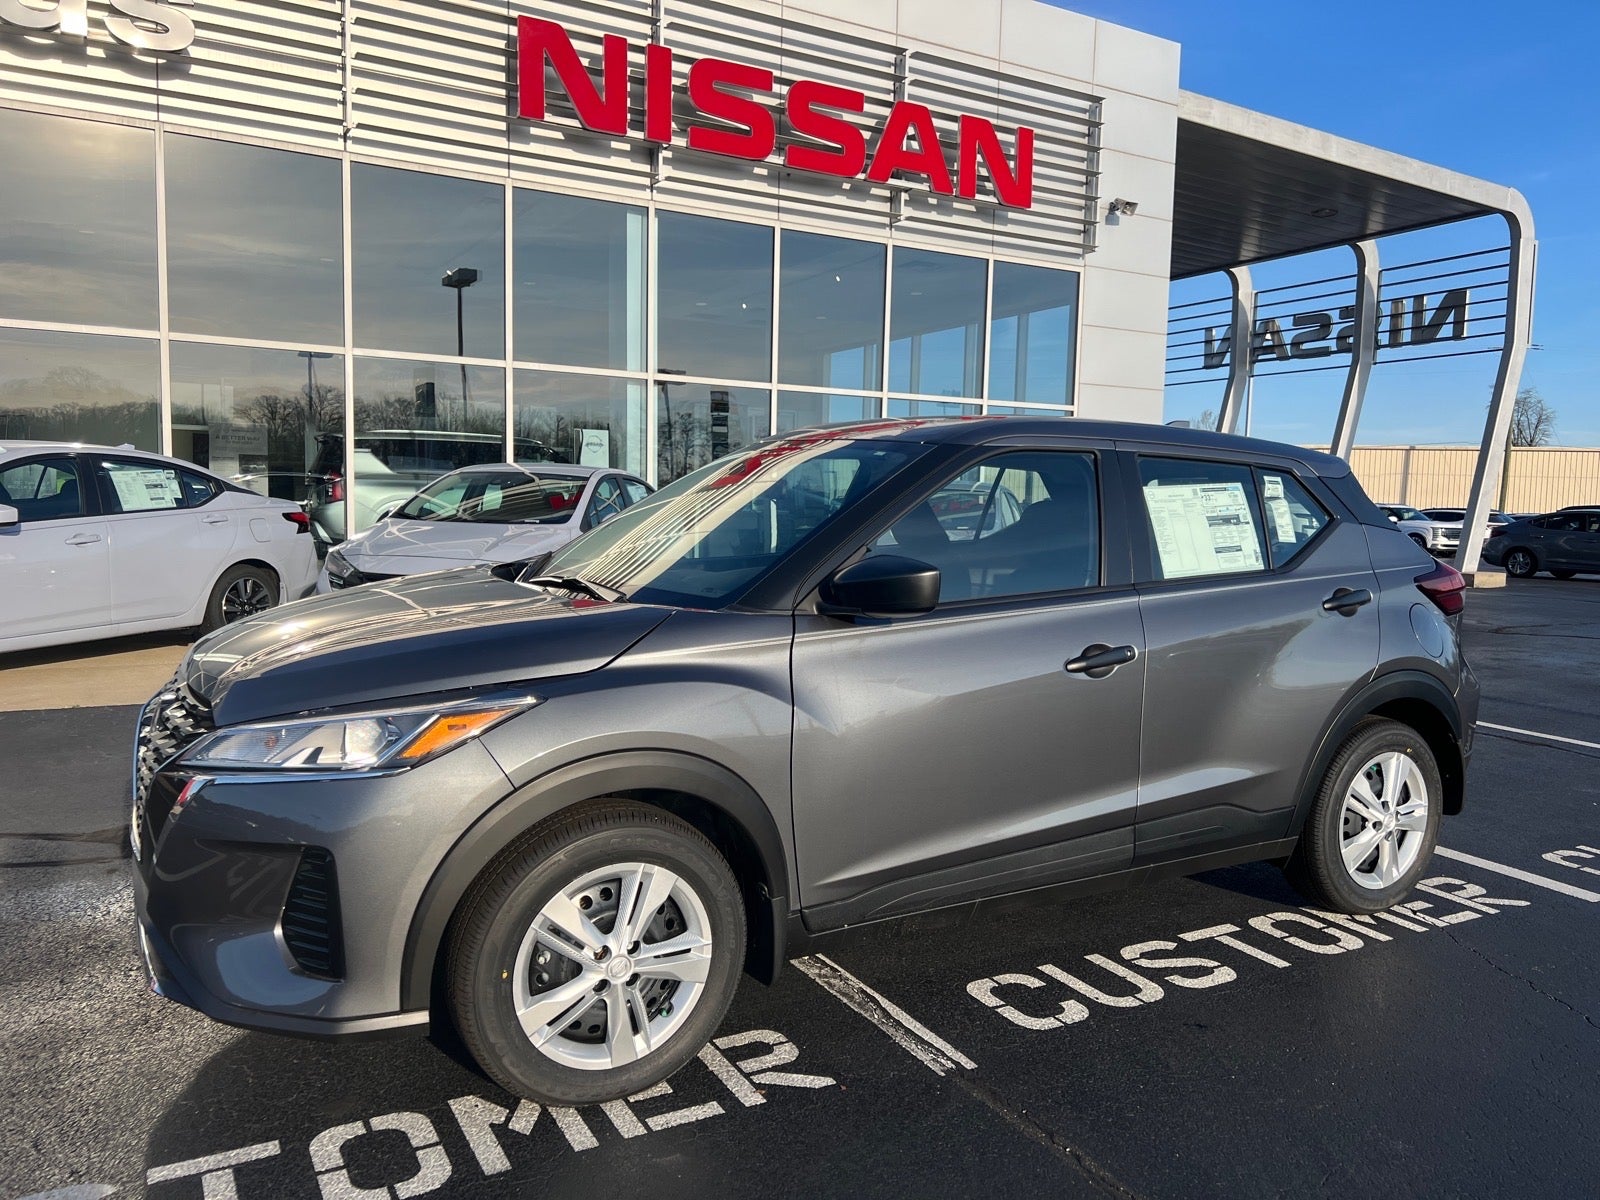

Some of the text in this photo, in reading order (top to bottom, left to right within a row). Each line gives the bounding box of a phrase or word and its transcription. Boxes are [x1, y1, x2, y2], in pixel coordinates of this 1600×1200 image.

[517, 15, 1035, 209] NISSAN
[965, 876, 1531, 1030] CUSTOMER
[14, 1029, 837, 1200] TOMER
